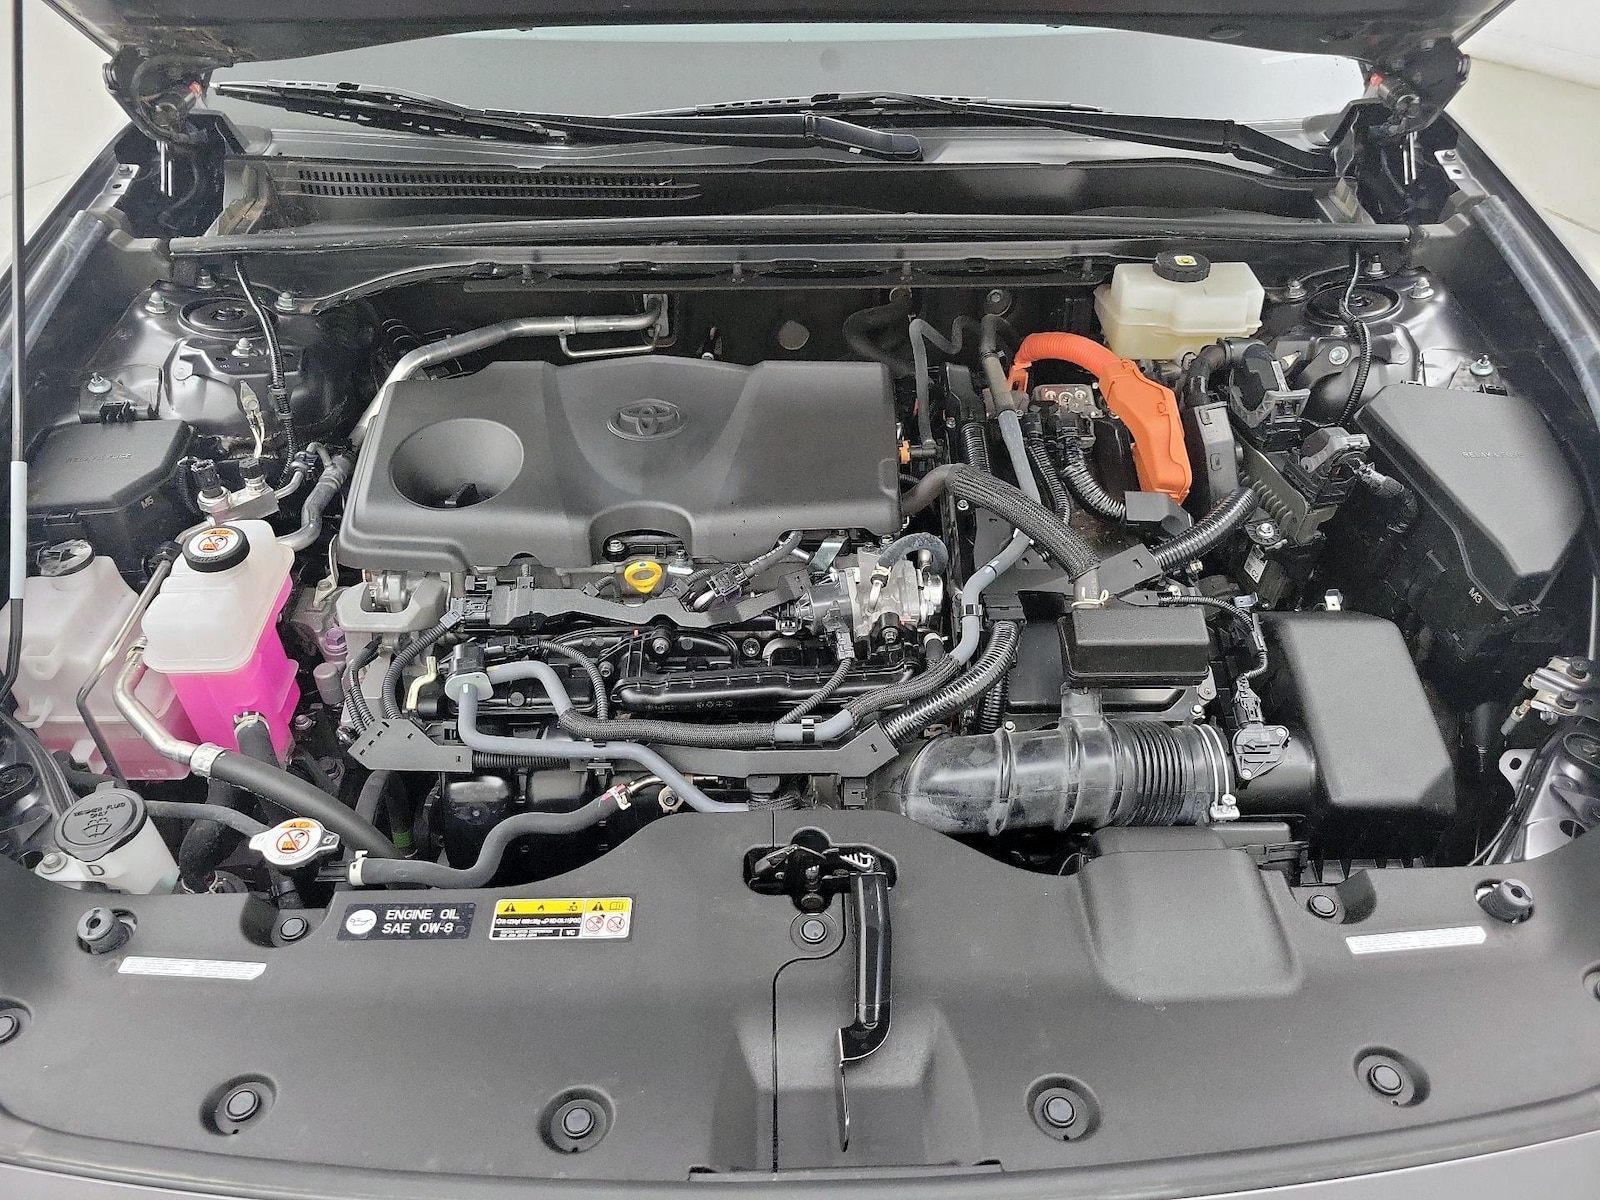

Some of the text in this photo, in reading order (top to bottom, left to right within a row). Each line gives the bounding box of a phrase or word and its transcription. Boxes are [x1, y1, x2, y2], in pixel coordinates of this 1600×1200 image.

[1468, 587, 1483, 604] M3
[385, 908, 461, 921] ENGINE OIL
[381, 923, 412, 934] SAE
